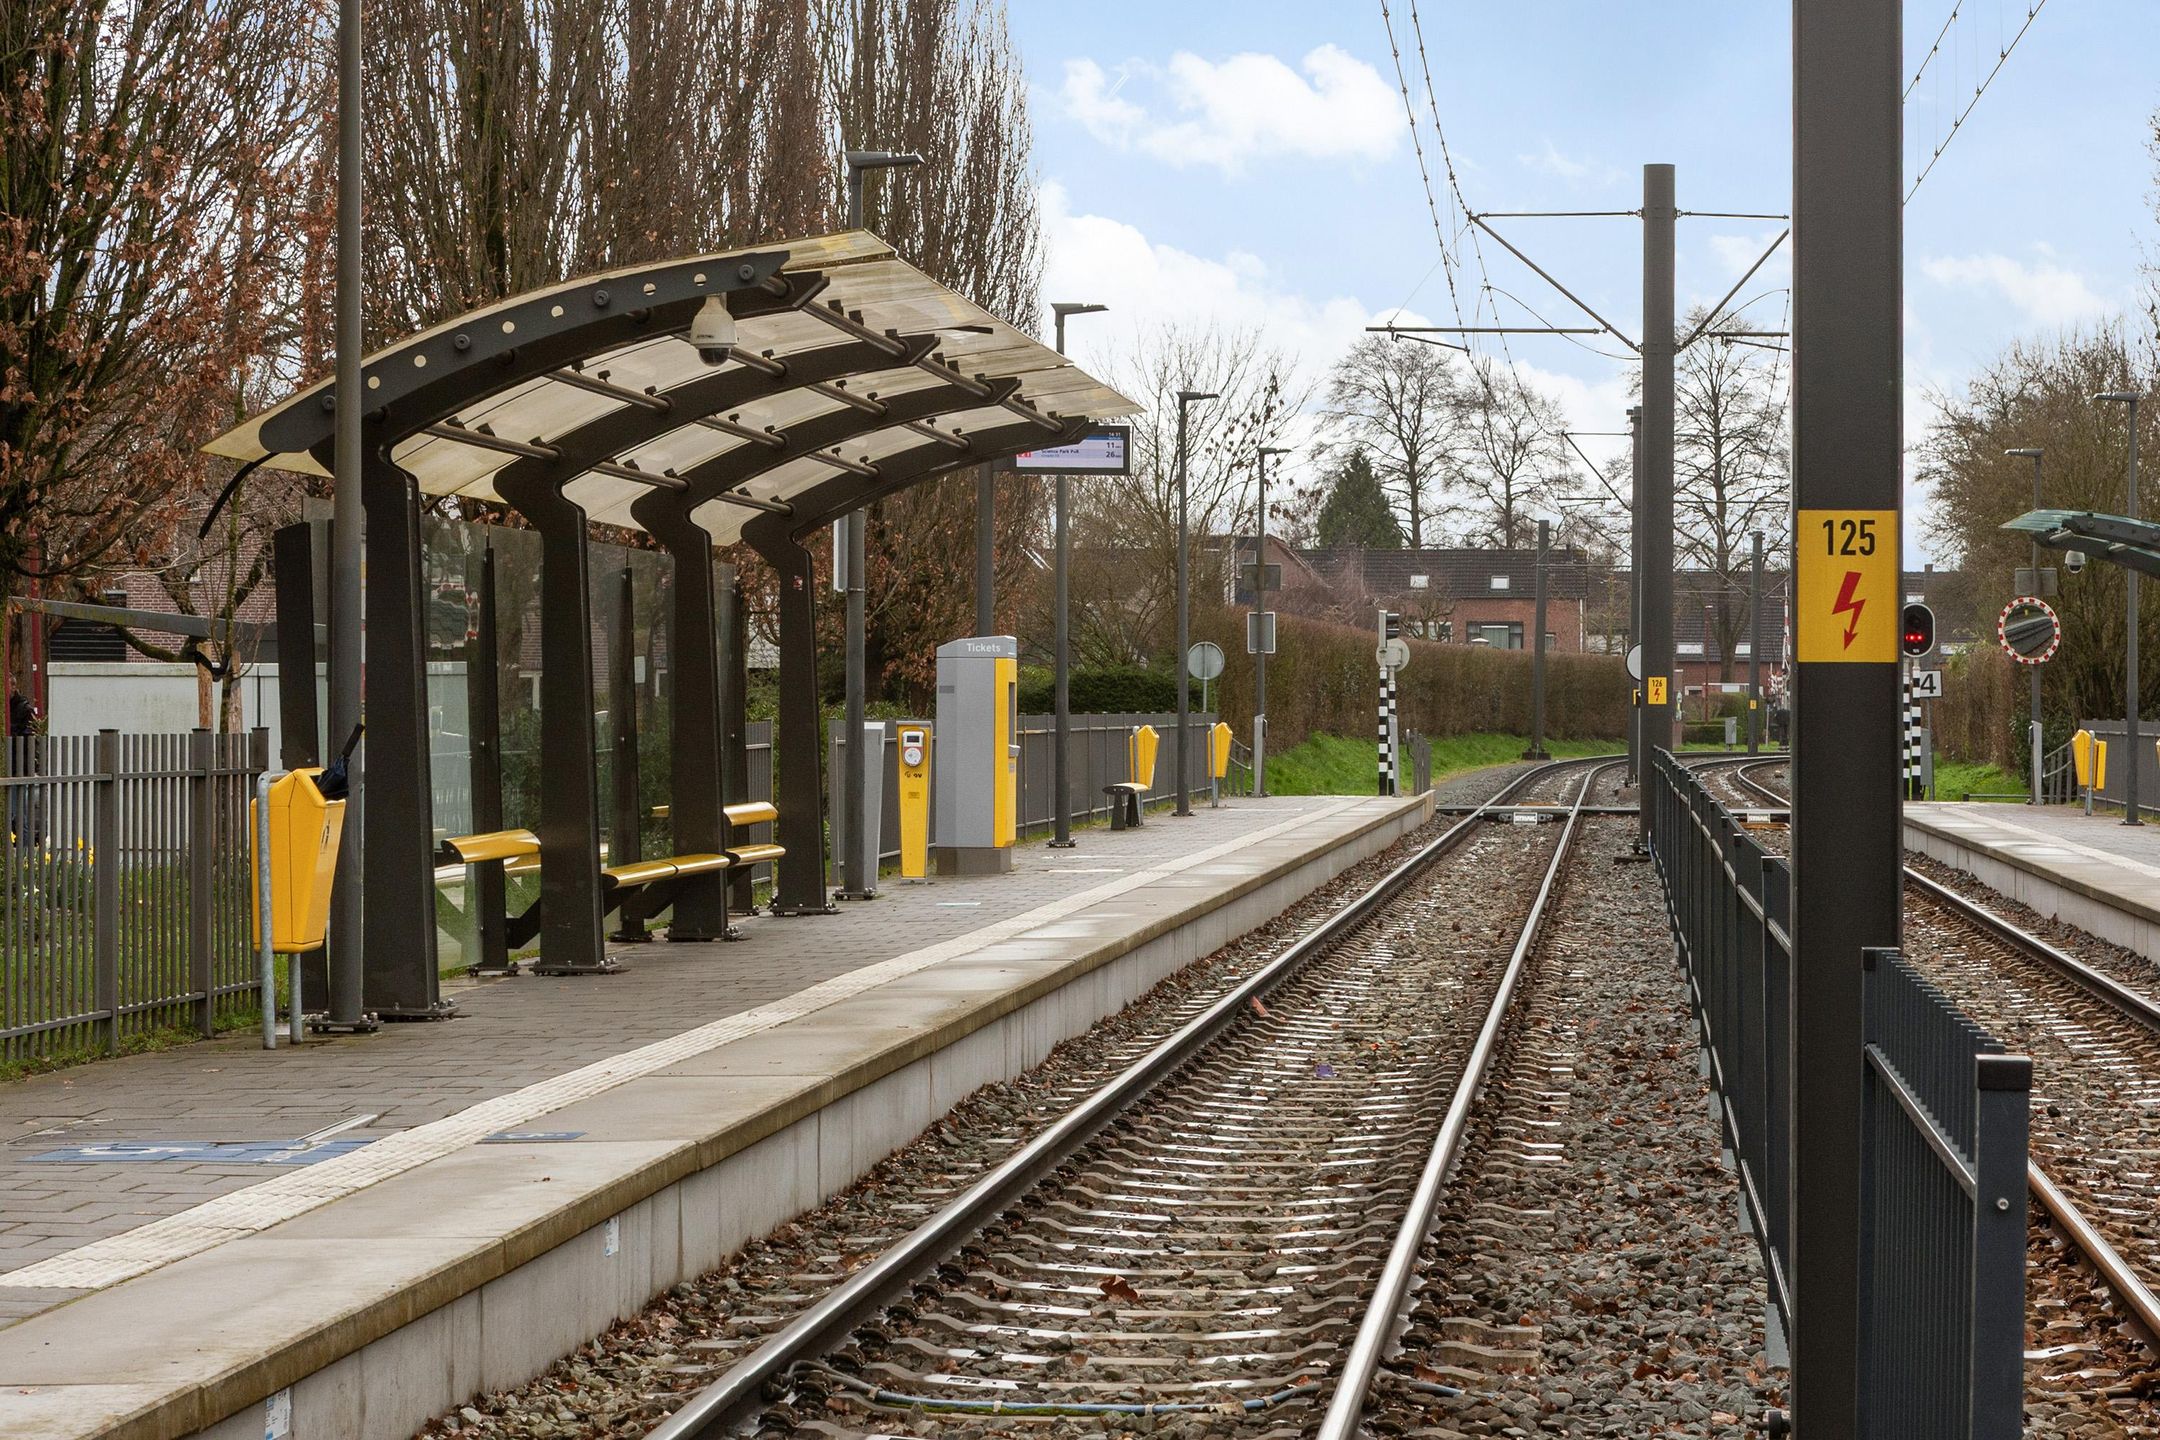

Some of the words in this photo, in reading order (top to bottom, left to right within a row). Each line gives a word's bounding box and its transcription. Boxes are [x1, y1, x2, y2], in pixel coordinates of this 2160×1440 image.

[1823, 519, 1876, 556] 125
[966, 643, 1001, 653] Tickets
[1920, 673, 1937, 694] 4
